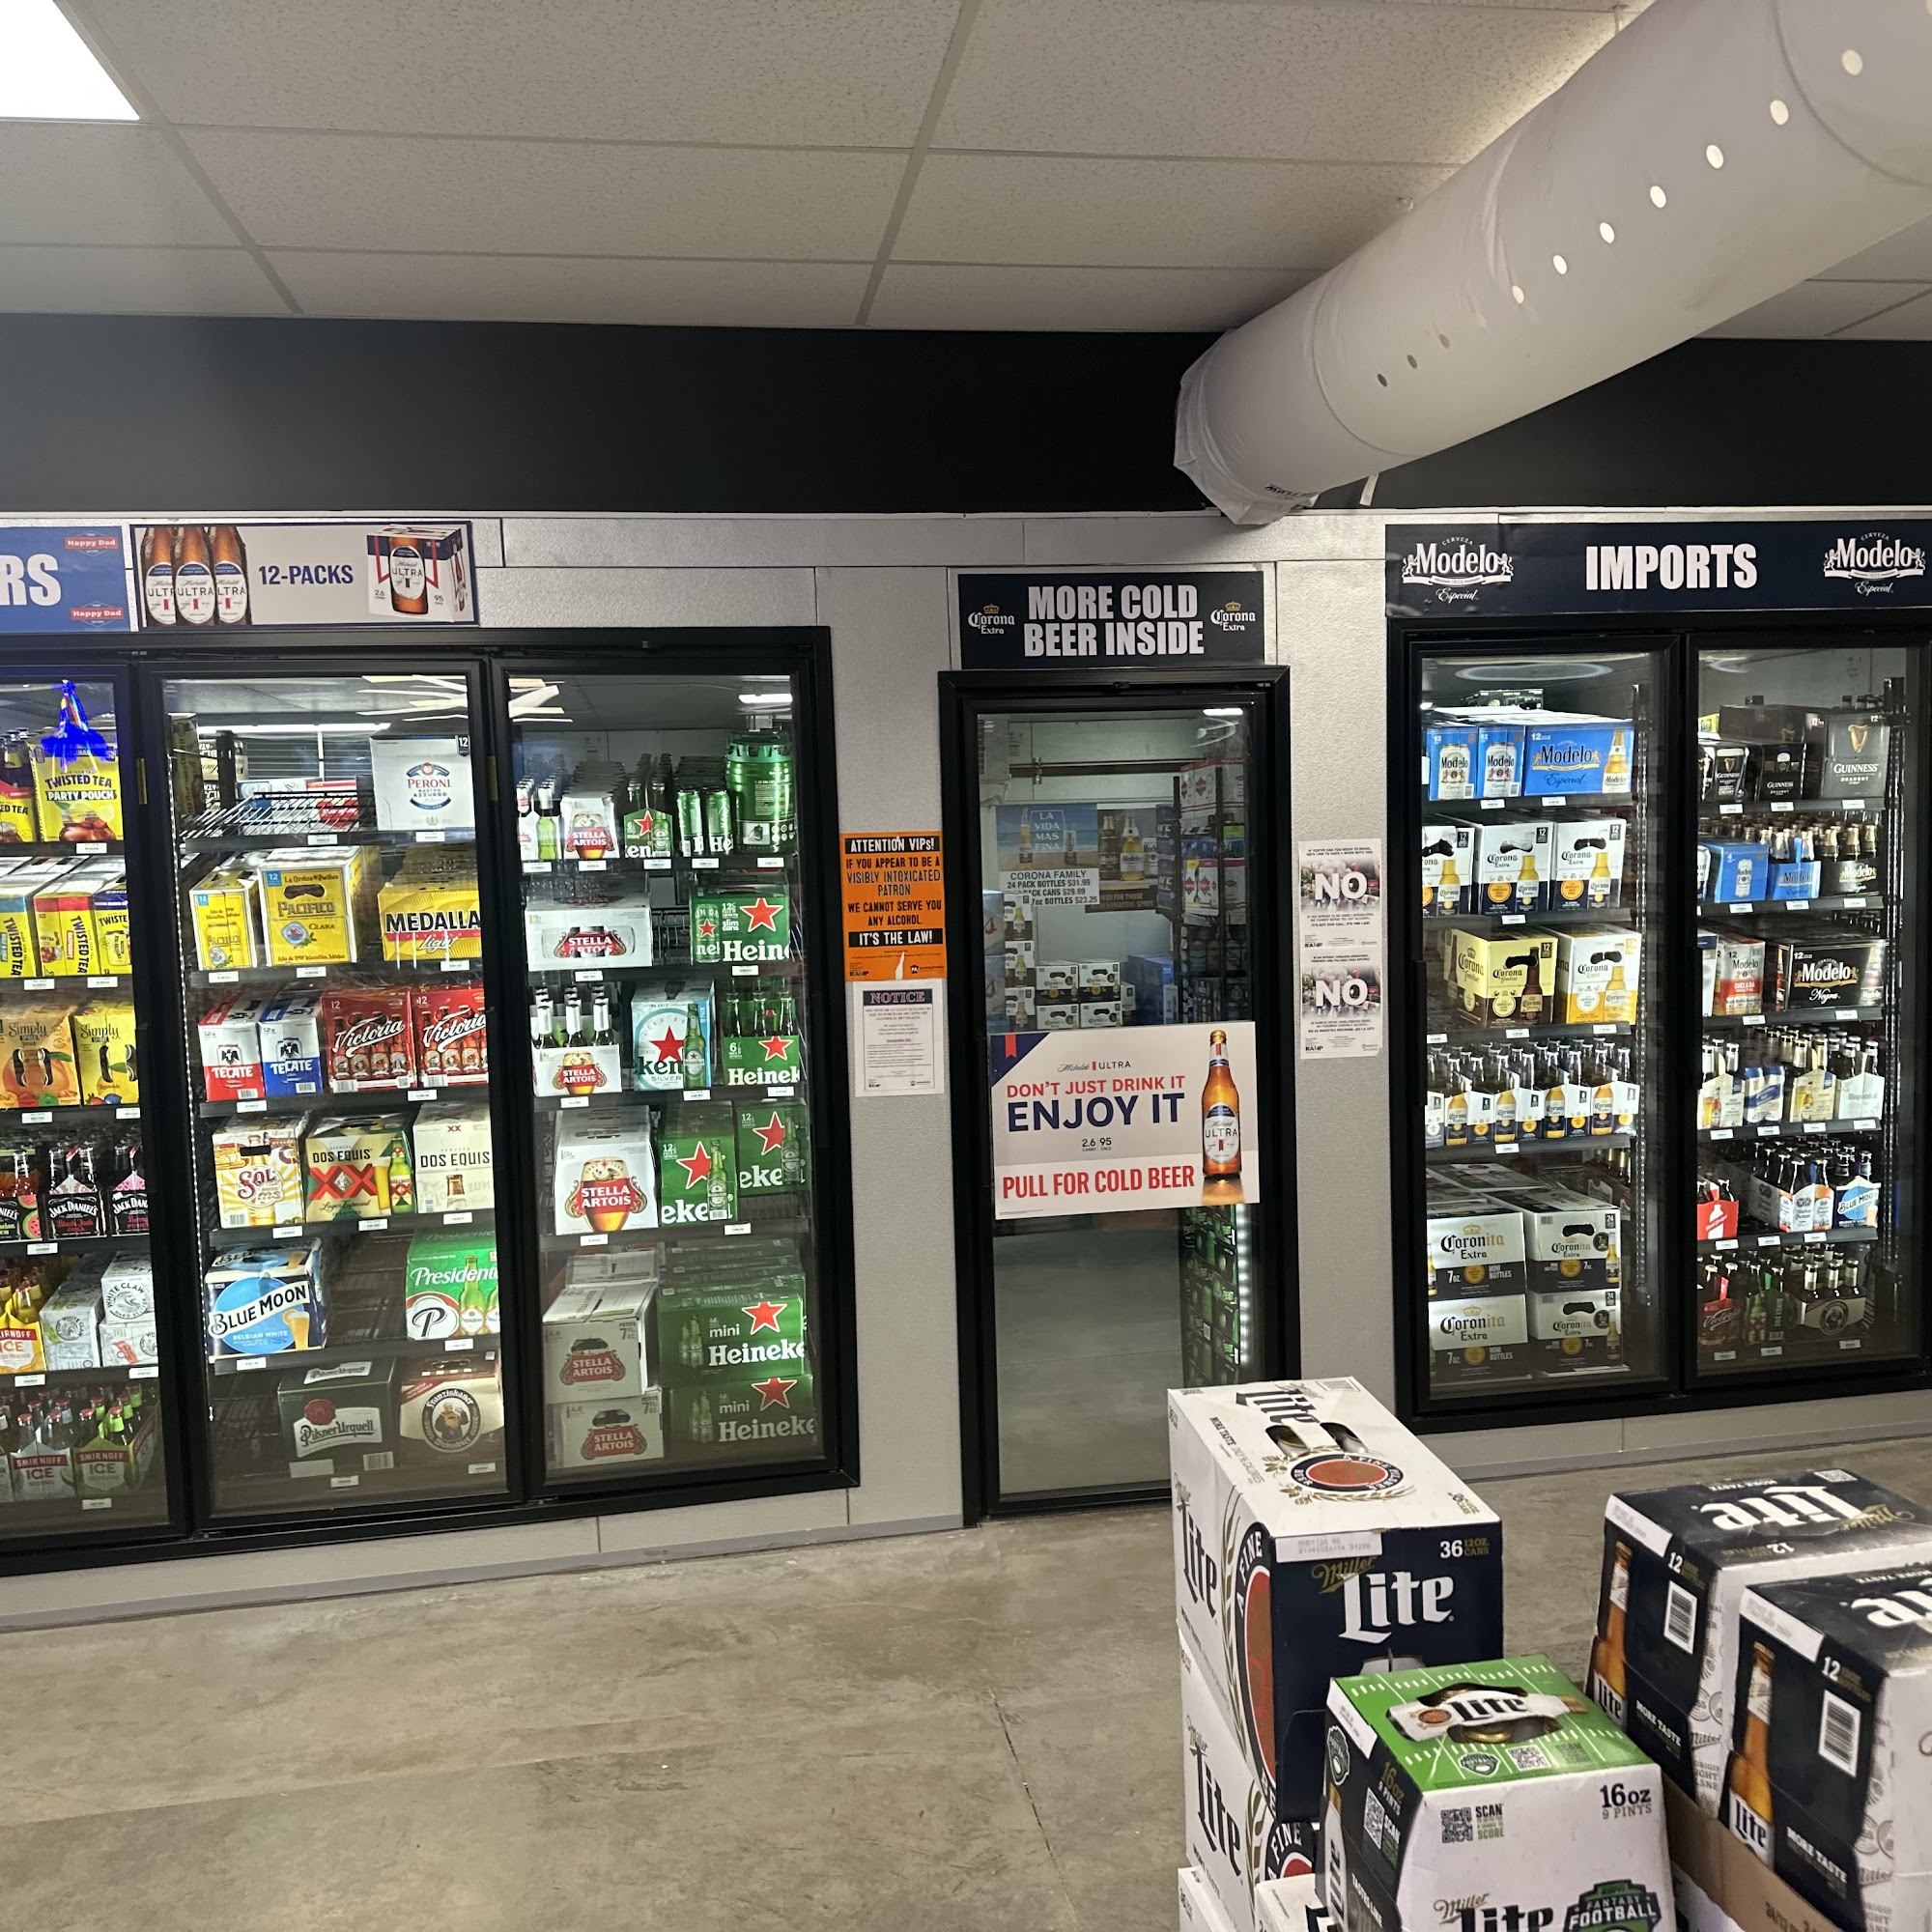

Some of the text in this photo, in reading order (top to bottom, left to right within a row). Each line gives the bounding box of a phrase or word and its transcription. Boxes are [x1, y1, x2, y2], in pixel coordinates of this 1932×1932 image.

[1415, 543, 1499, 574] Modelo
[1836, 538, 1913, 568] Modelo
[259, 564, 355, 585] 12-PACKS
[391, 567, 423, 577] ULTRA
[1586, 543, 1757, 591] IMPORTS
[177, 587, 214, 596] ULTRA
[1435, 587, 1479, 604] Especial
[1855, 581, 1894, 596] Especial
[1028, 584, 1198, 620] MORE COLD
[968, 611, 1015, 629] Corona
[1210, 609, 1256, 626] Corona
[980, 625, 1005, 635] Extra
[1222, 621, 1246, 632] Extra
[1024, 621, 1205, 657] BEER INSIDE
[459, 737, 469, 747] 12
[1441, 756, 1468, 769] Modelo
[1541, 745, 1592, 765] Modelo
[1833, 763, 1879, 774] GUINNESS
[44, 774, 112, 789] TWISTED TEA
[408, 779, 451, 788] PERONI
[48, 790, 115, 801] PARTY POUCH
[1039, 811, 1054, 820] LA
[1034, 822, 1061, 831] VIDA
[572, 830, 605, 839] STELLA
[573, 838, 608, 846] ARTOIS
[850, 838, 934, 853] ATTENTION VIPs!
[845, 856, 940, 869] IF YOU APPEAR TO BE A
[1487, 851, 1519, 864] Corona
[1561, 850, 1592, 863] Corona
[847, 869, 941, 884] VISIBLY INTOXICATED
[1010, 870, 1087, 881] CORONA FAMILY
[878, 885, 911, 896] PATRON
[1017, 880, 1036, 889] PACK
[1315, 871, 1368, 900] NO
[277, 901, 336, 918] PACIFICO
[848, 899, 942, 913] WE CANNOT SERVE YOU
[99, 915, 128, 927] TWISTE
[386, 911, 481, 932] MEDALLA
[867, 916, 884, 926] ANY
[568, 937, 612, 946] STELLA
[859, 930, 933, 946] IT'S THE LAW!
[1578, 964, 1608, 975] Corona
[1733, 959, 1759, 969] Modelo
[1492, 968, 1522, 979] Corona
[1802, 962, 1851, 982] Modelo
[869, 991, 925, 1004] NOTICE
[1315, 978, 1368, 1007] NO
[9, 1021, 49, 1041] Simply
[80, 1022, 121, 1039] Simply
[332, 1019, 406, 1058] Victoria
[212, 1065, 254, 1079] TECATE
[272, 1060, 313, 1075] TECATE
[1098, 1061, 1131, 1069] ULTRA
[1007, 1075, 1185, 1098] DON'T JUST DRINK IT
[1008, 1093, 1185, 1132] ENJOY IT
[1205, 1128, 1238, 1138] ULTRA
[1082, 1138, 1096, 1148] 2.6
[1099, 1137, 1112, 1146] 95
[313, 1149, 372, 1163] DOS EQUIS
[420, 1151, 490, 1168] DOS EQUIS
[238, 1166, 276, 1199] SOL
[308, 1164, 378, 1201] XX
[1003, 1165, 1195, 1199] PULL FOR COLD BEER
[582, 1187, 630, 1198] STELLA
[49, 1201, 99, 1218] JACK DANIEL'S
[582, 1196, 632, 1208] ARTOIS
[1440, 1234, 1505, 1254] Coronita
[1551, 1241, 1591, 1254] Coronita
[1461, 1249, 1488, 1260] Extra
[1489, 1270, 1513, 1279] BOTTLES
[106, 1282, 145, 1308] WHITE CLAW
[211, 1285, 307, 1335] BLUE MOON
[709, 1323, 740, 1338] mini
[1440, 1316, 1506, 1336] Coronita
[572, 1357, 611, 1368] STELLA
[573, 1366, 613, 1378] ARTOIS
[426, 1389, 474, 1409] Franziskaner
[299, 1420, 375, 1448] Pilsner Urquell
[16, 1457, 63, 1467] SMIRNOFF
[26, 1468, 54, 1480] ICE
[1439, 1540, 1463, 1559] 36
[1463, 1547, 1489, 1556] CANS
[1668, 1551, 1684, 1574] 12
[1338, 1572, 1454, 1644] Lite
[1822, 1656, 1842, 1681] 12
[1597, 1673, 1622, 1719] Lite
[1449, 1694, 1529, 1723] Lite
[1635, 1699, 1682, 1747] MORE TASTE
[1600, 1782, 1652, 1808] 16oz
[1475, 1805, 1503, 1818] SCAN
[1602, 1804, 1653, 1820] 9 PINTS
[1735, 1799, 1767, 1848] Lite
[1477, 1827, 1505, 1839] SCORE
[1270, 1822, 1302, 1864] FINE
[1786, 1825, 1848, 1884] MORE TASTE
[1434, 1893, 1489, 1926] Miller
[1586, 1894, 1640, 1910] FANTASY
[1569, 1903, 1658, 1930] FOOTBALL
